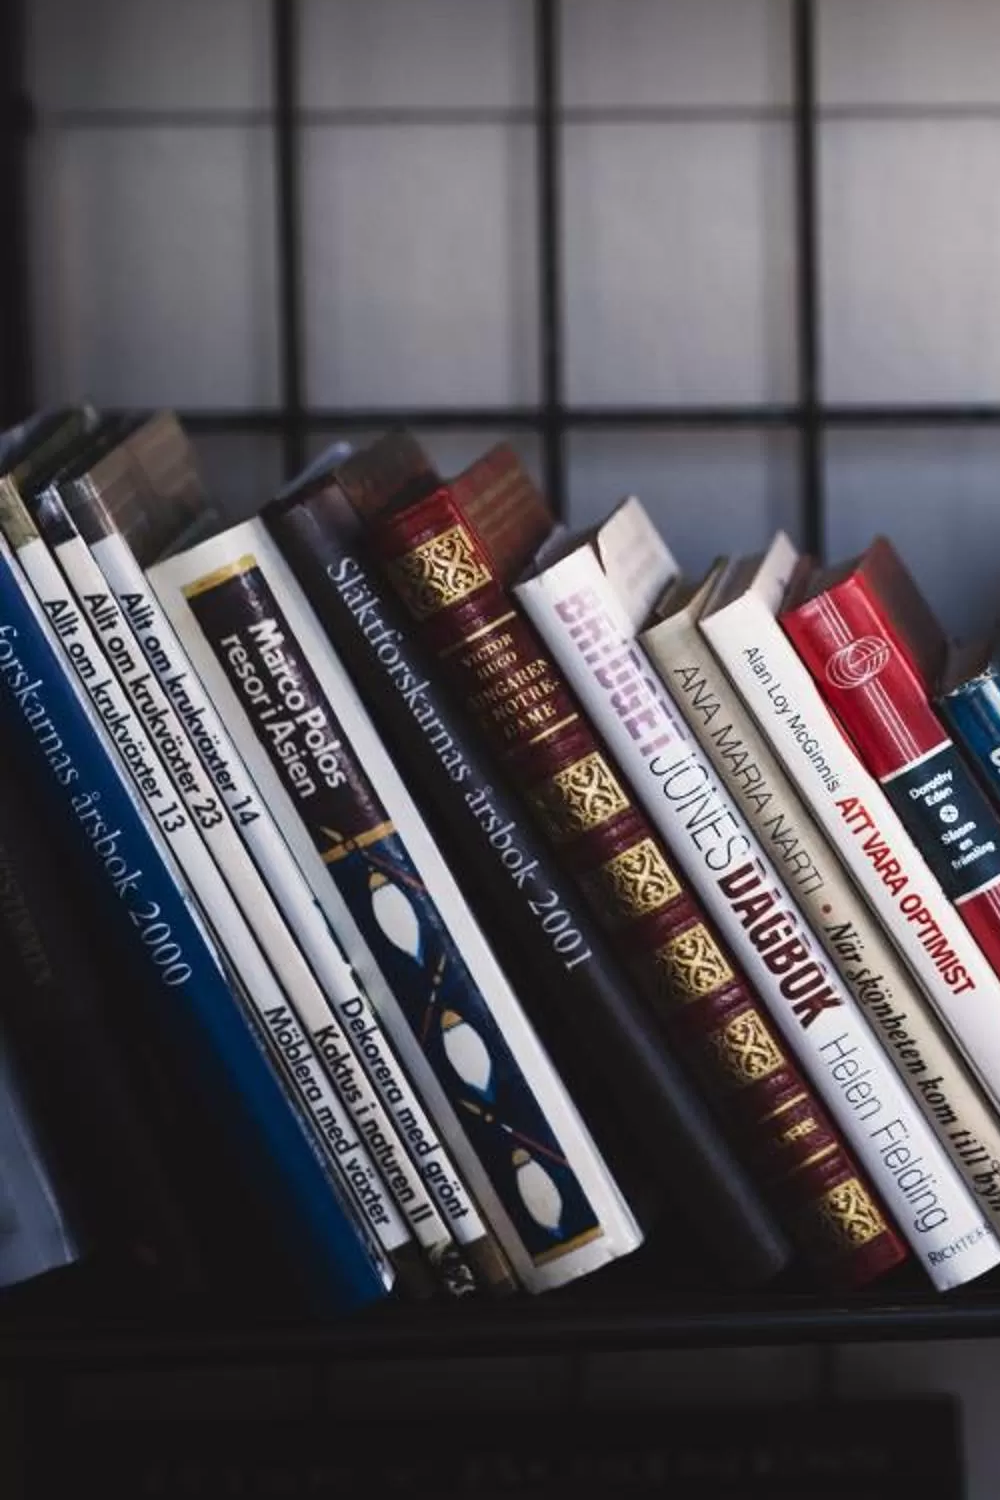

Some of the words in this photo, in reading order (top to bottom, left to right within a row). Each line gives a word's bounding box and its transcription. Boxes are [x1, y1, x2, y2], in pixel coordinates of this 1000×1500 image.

[83, 593, 124, 636] Allt
[108, 636, 137, 674] om
[41, 599, 81, 641] Allt
[69, 642, 97, 679] om
[85, 678, 170, 804] krukväxter
[157, 801, 186, 833] 13
[119, 593, 155, 631] Allt
[145, 635, 172, 673] om
[160, 672, 238, 792] krukväxter
[231, 795, 261, 826] 14
[220, 633, 272, 705] resor
[247, 618, 307, 711] Marco
[295, 705, 347, 789] Polos
[259, 704, 284, 720] i
[122, 673, 211, 797] krukväxter
[264, 720, 317, 799] Asien
[326, 557, 472, 782] Släktforskarnas
[464, 786, 539, 889] årsbok
[527, 889, 593, 970] 2001
[909, 769, 953, 800] Dorothy
[192, 797, 223, 829] 23
[742, 647, 773, 685] Alan
[767, 683, 792, 715] Loy
[786, 713, 841, 794] McGinnis
[834, 797, 876, 835] ATT
[861, 830, 910, 897] VARA
[899, 893, 977, 996] OPTIMIST
[925, 787, 953, 807] Eden
[71, 791, 141, 897] årsbok
[129, 901, 193, 985] 2000
[673, 667, 721, 726] ANA
[710, 723, 773, 814] MARIA
[762, 813, 825, 895] NARTI
[825, 921, 863, 967] När
[847, 965, 928, 1075] skönheten
[916, 1073, 959, 1126] kom
[948, 1129, 991, 1167] till
[712, 854, 847, 1029] DAGBOK
[263, 1001, 331, 1102] Möblera
[315, 1103, 360, 1159] med
[341, 1152, 394, 1231] växter
[307, 1025, 374, 1103] Kaktus
[339, 996, 414, 1104] Dekorera
[397, 1101, 439, 1156] med
[420, 1155, 472, 1219] grönt
[355, 1102, 377, 1116] i
[355, 1117, 417, 1203] naturen
[819, 1032, 882, 1121] Helen
[869, 1118, 949, 1233] Fielding
[409, 1203, 434, 1223] II
